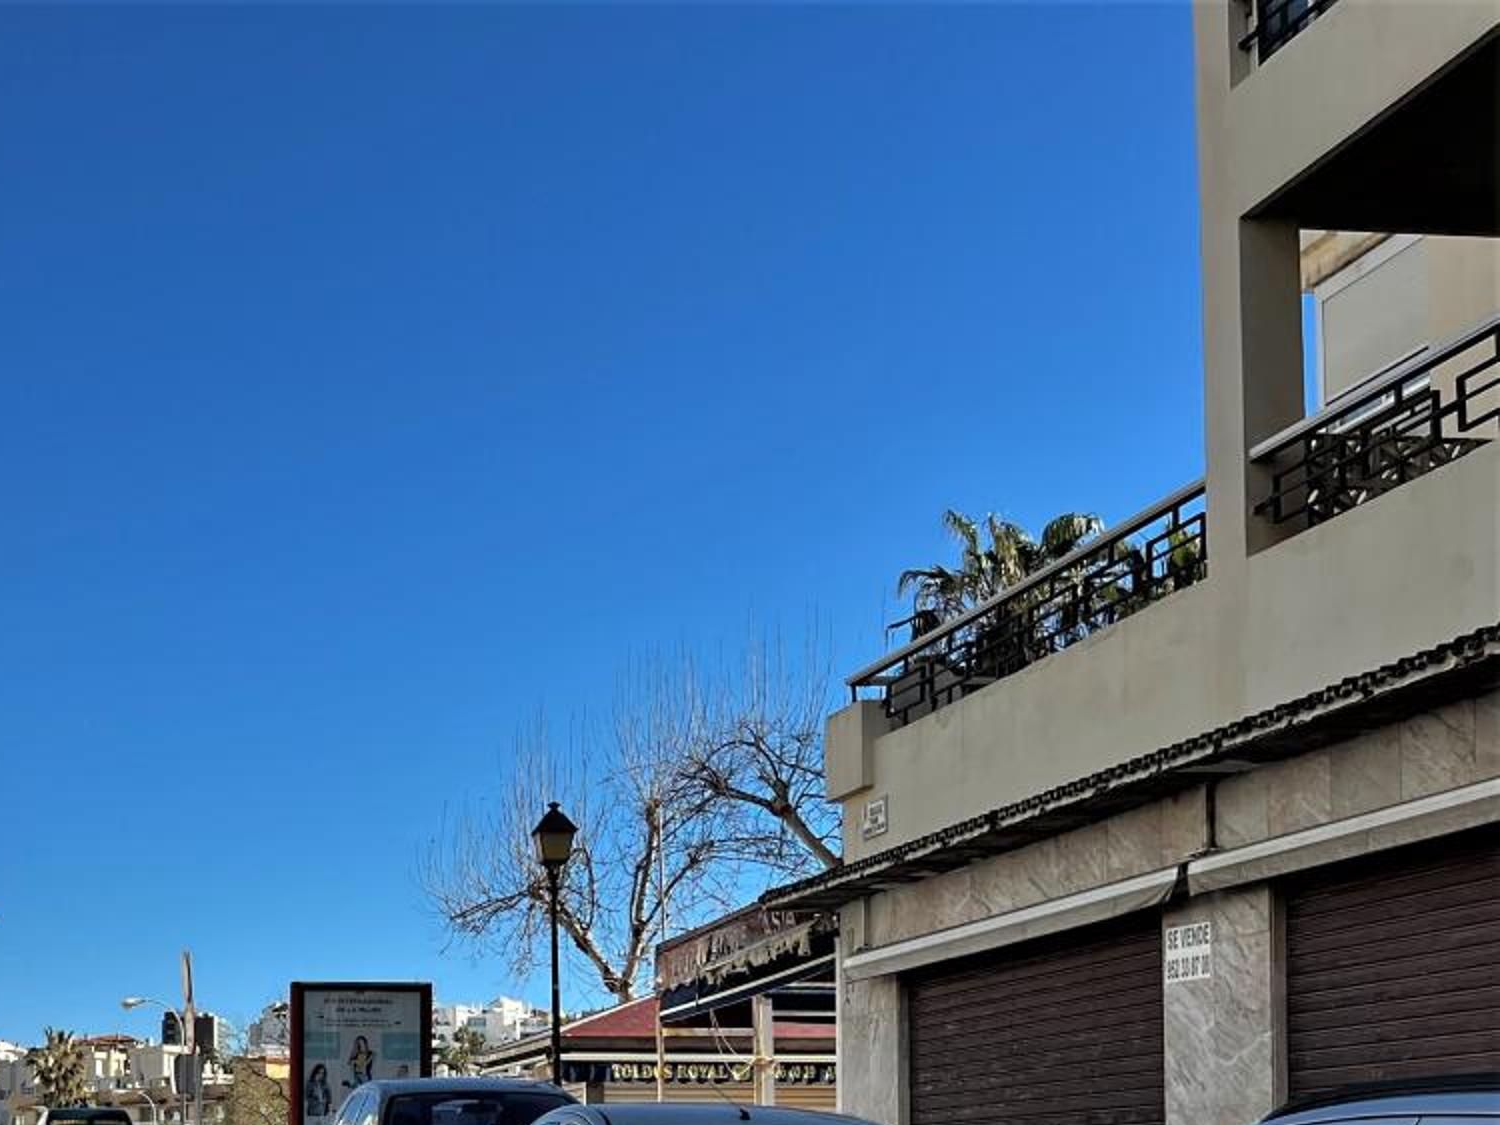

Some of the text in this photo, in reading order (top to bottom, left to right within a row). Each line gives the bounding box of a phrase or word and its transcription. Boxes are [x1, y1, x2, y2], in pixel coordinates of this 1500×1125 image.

[1167, 924, 1208, 950] SE VENDE
[676, 1064, 727, 1080] ROYAL
